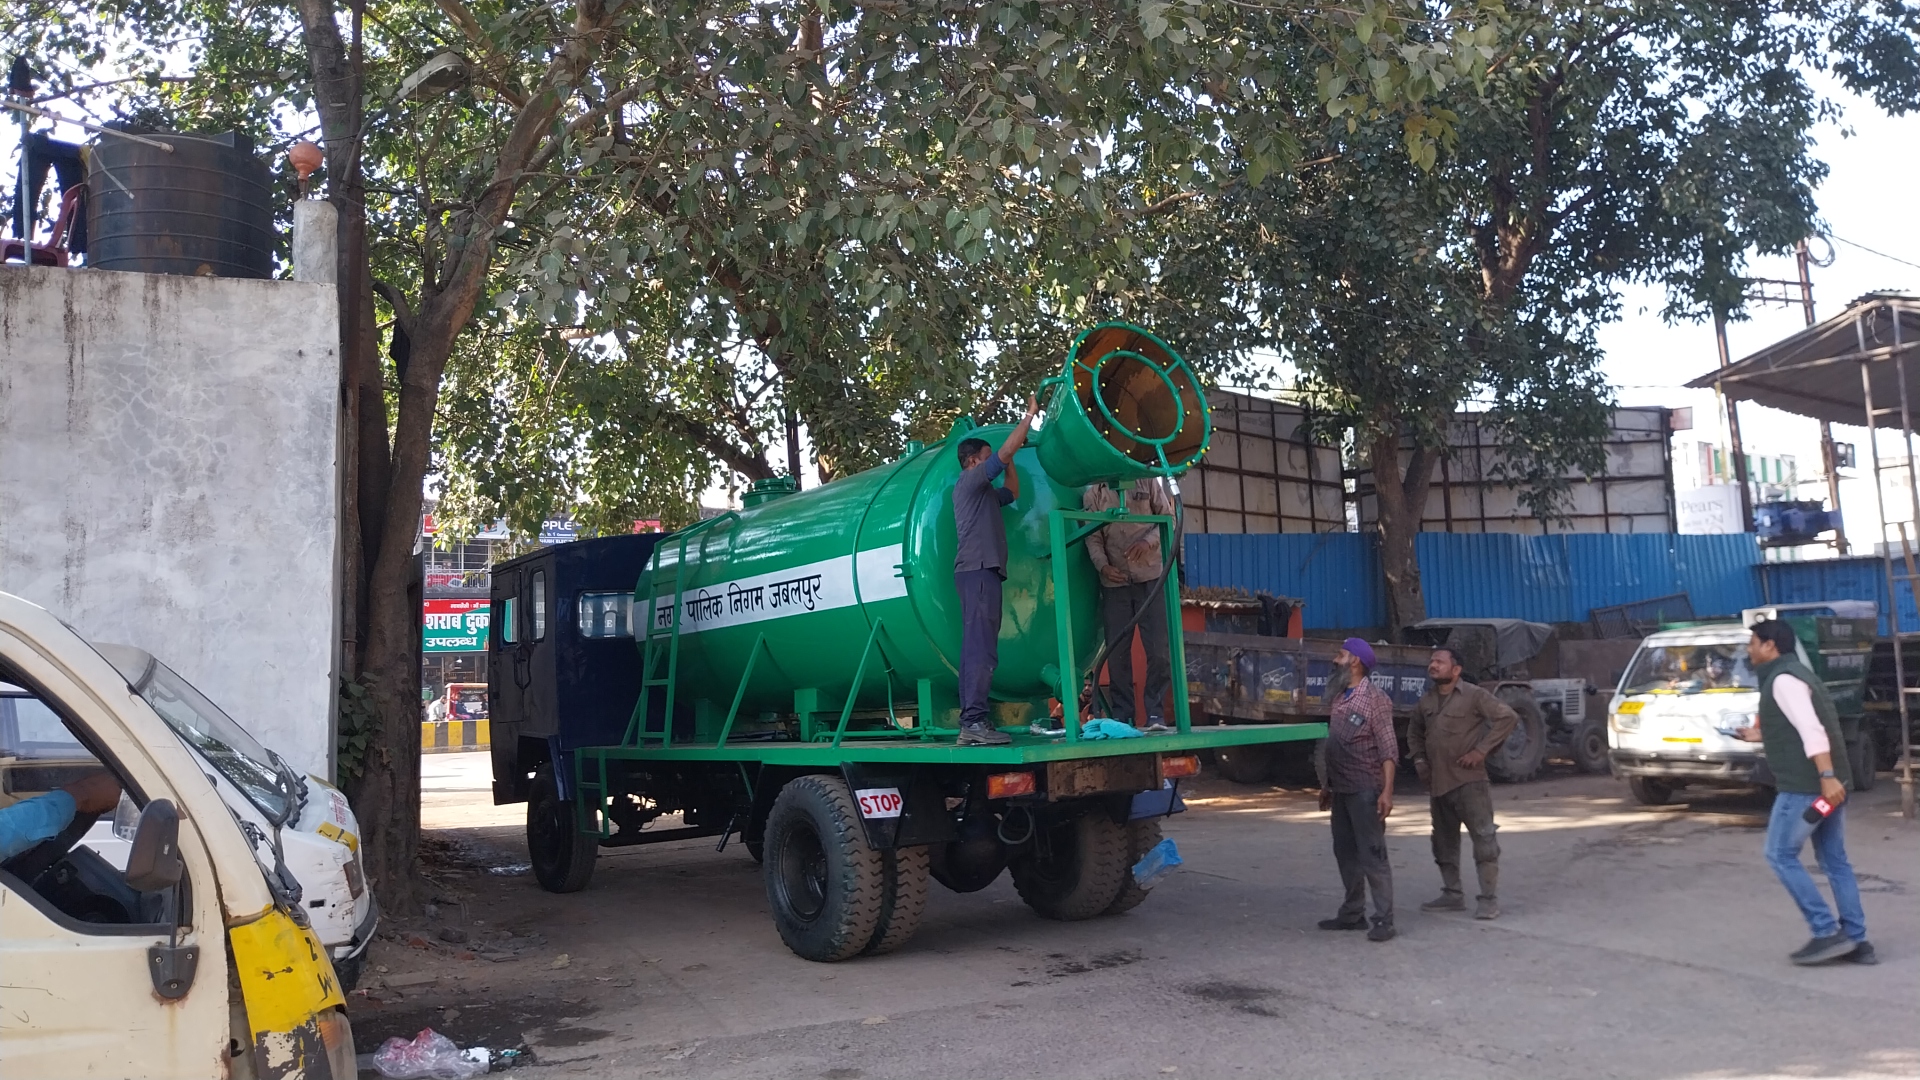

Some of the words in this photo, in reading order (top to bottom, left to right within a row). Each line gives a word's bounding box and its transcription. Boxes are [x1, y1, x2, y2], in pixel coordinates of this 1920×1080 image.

[686, 589, 723, 622] पालिक
[727, 582, 765, 616] निगम
[768, 574, 823, 611] जबलपुर
[425, 613, 462, 630] शराब
[425, 637, 478, 648] उपलब्ध
[860, 793, 901, 815] STOP
